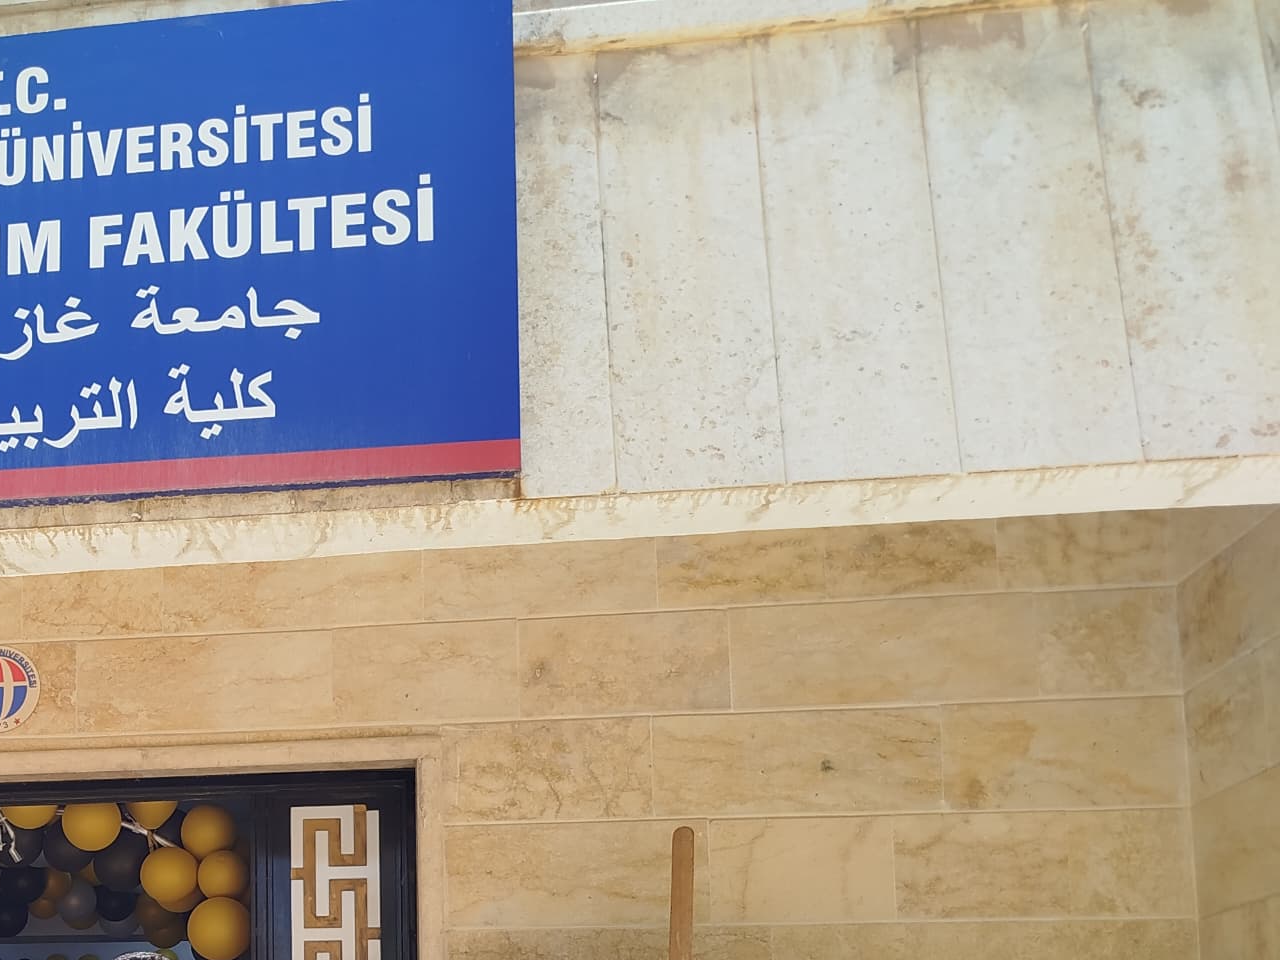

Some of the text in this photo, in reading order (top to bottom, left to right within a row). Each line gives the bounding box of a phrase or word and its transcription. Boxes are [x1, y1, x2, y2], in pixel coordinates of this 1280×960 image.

[88, 173, 434, 270] FAKÜLTESİ
[130, 284, 321, 340] جامعة
[163, 363, 276, 440] كلية
